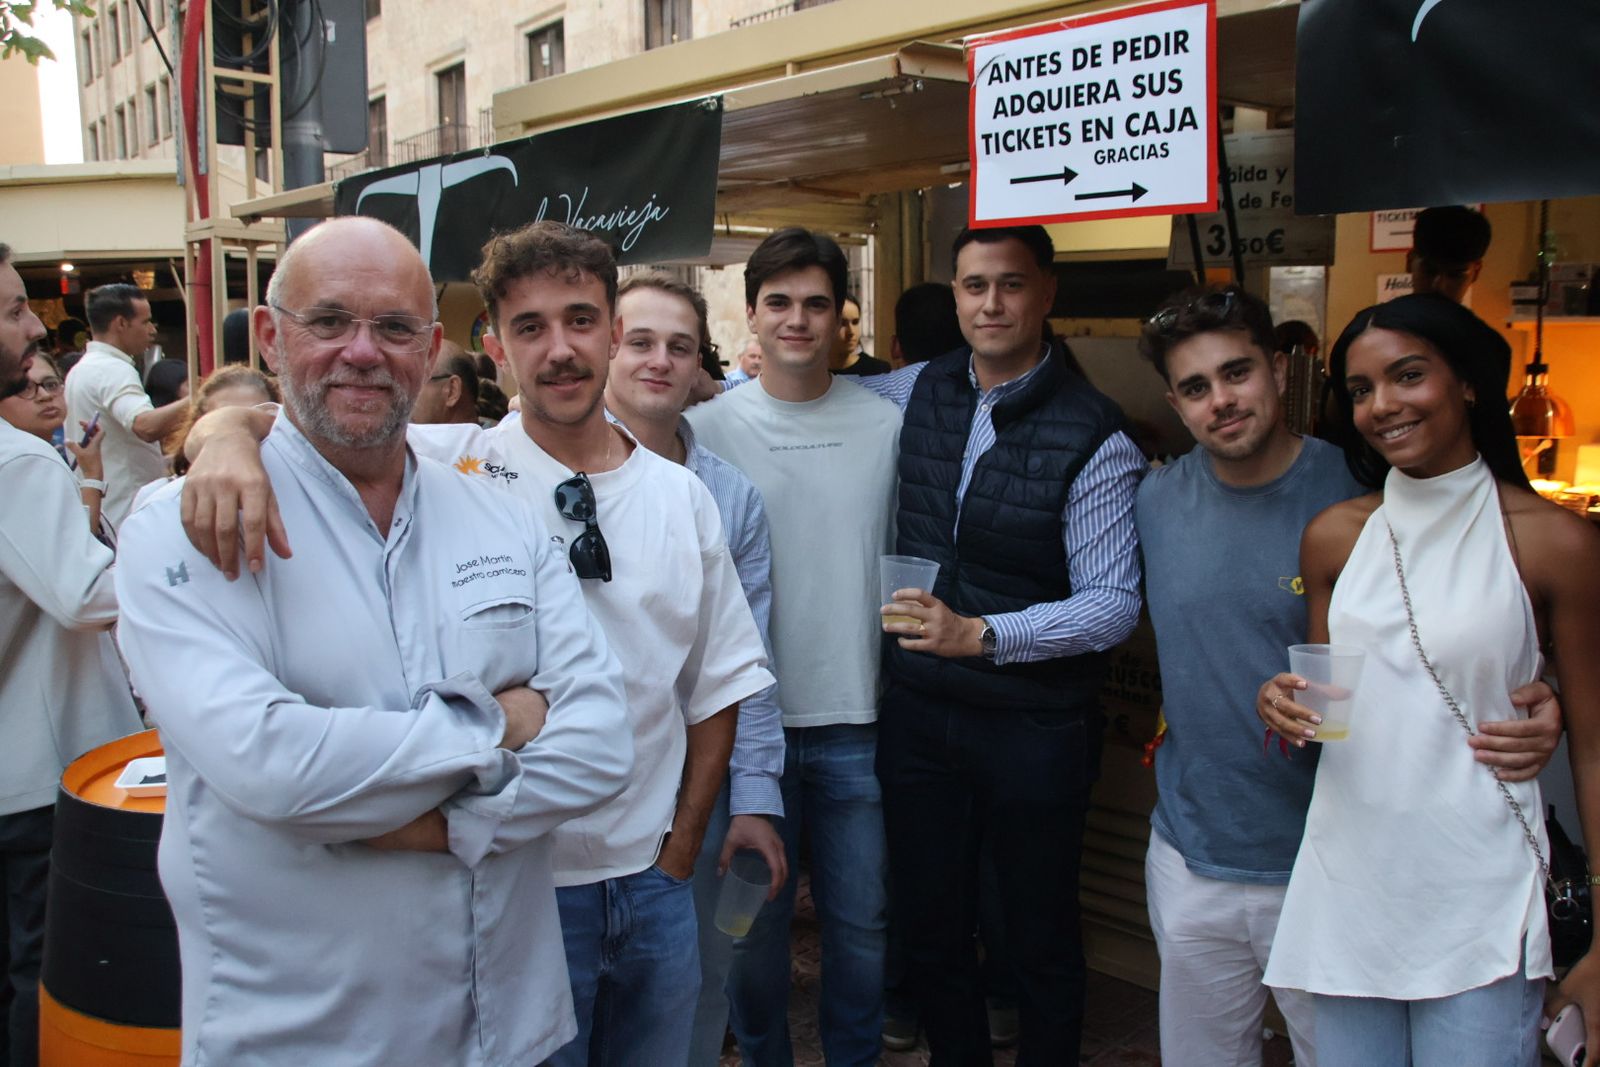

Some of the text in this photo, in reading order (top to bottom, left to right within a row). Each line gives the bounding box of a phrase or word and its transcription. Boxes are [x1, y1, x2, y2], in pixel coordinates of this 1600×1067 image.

[987, 29, 1190, 86] ANTES DE PEDIR
[992, 68, 1183, 120] ADQUIERA SUS
[981, 106, 1199, 156] TICKETS EN CAJA
[1093, 142, 1170, 165] GRACIAS
[1217, 165, 1289, 185] bida y
[1238, 192, 1263, 209] de
[1270, 191, 1293, 209] Fe
[456, 559, 480, 574] Jose
